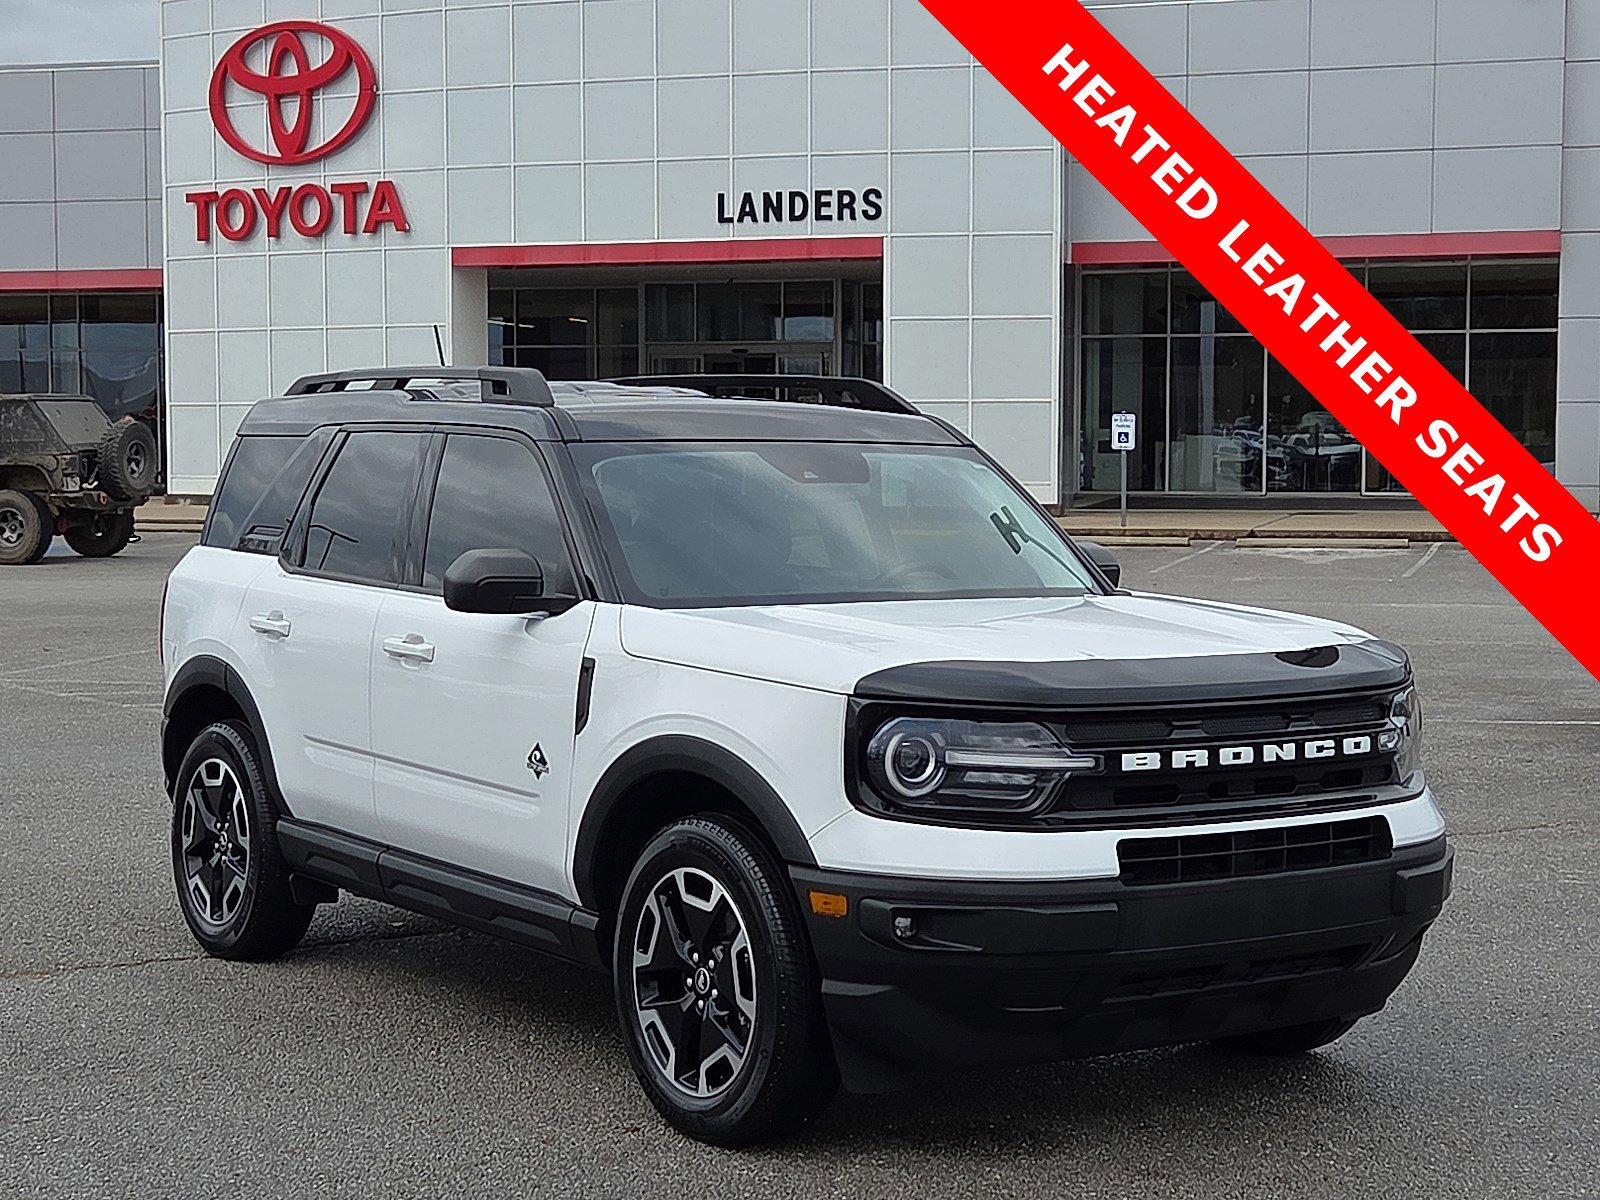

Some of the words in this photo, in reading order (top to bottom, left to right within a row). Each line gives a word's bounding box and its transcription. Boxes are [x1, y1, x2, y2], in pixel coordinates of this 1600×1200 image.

[186, 180, 410, 242] TOYOTA
[717, 188, 883, 224] LANDERS
[1121, 735, 1372, 772] BRONCO
